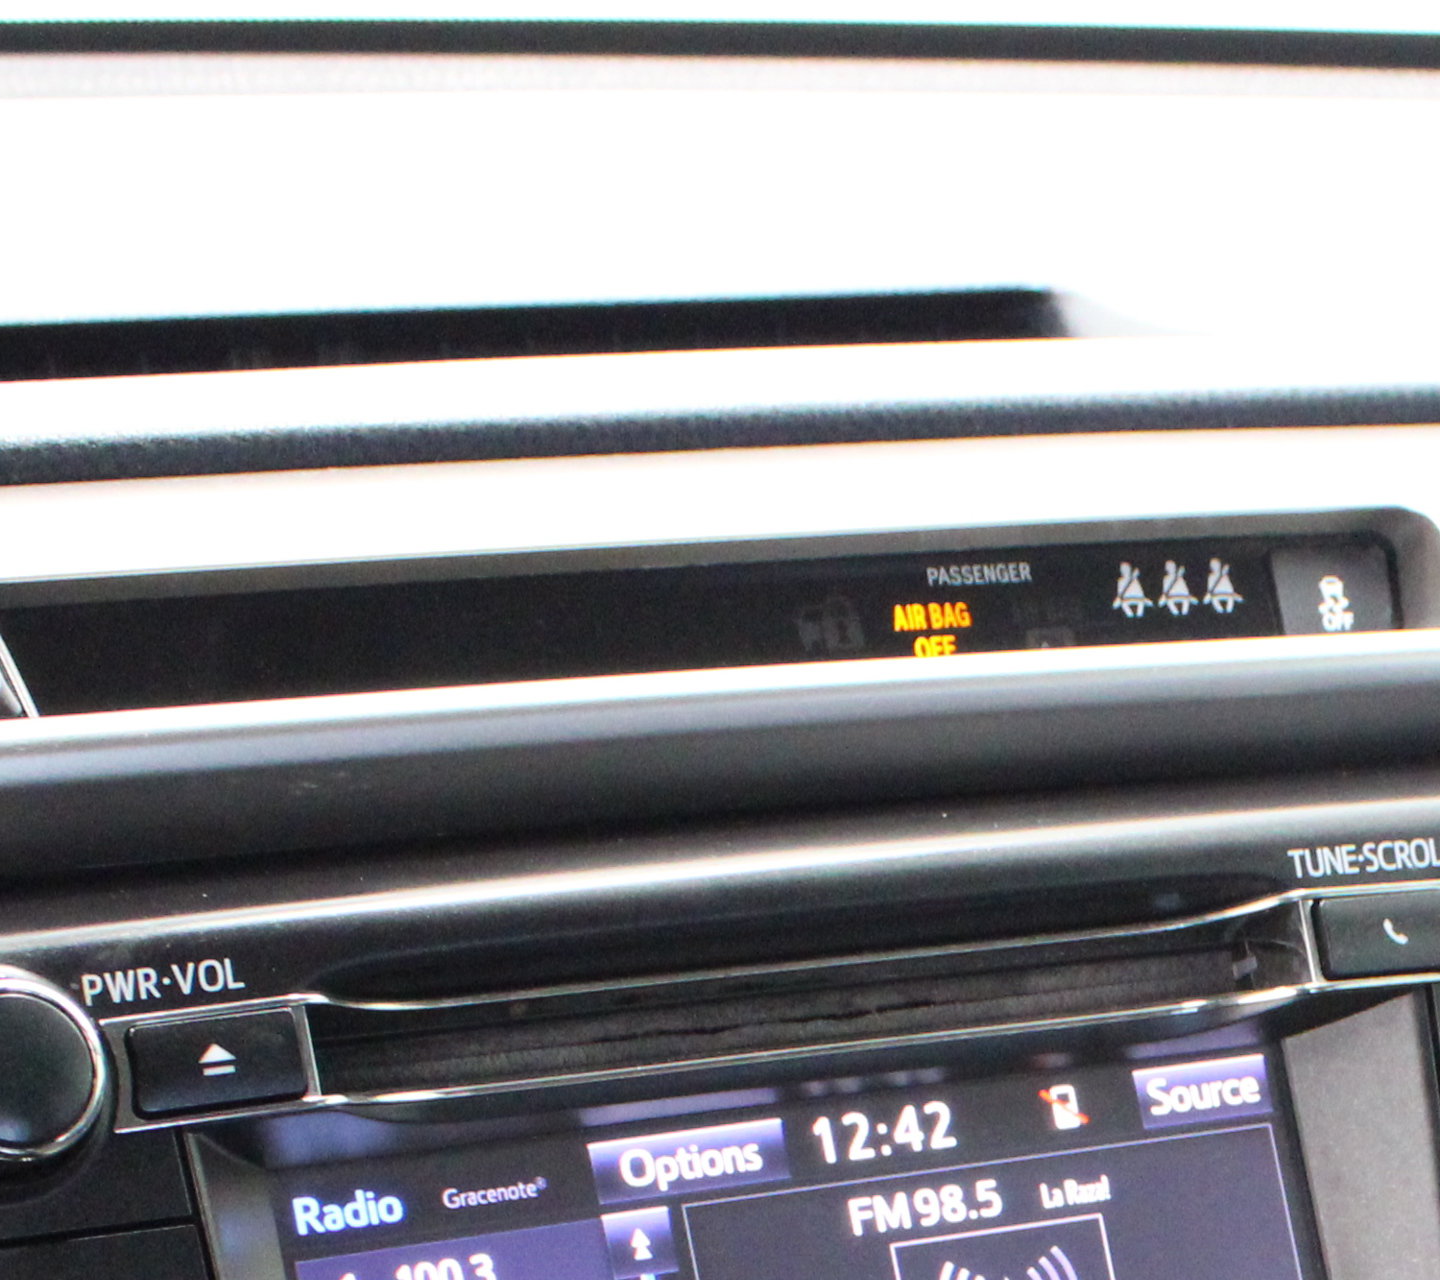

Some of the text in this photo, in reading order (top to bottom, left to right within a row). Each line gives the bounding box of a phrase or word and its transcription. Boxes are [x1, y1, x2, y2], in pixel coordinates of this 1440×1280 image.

[926, 561, 1033, 587] PASSENGER
[893, 601, 972, 632] AIR BAG
[1145, 1075, 1262, 1116] Source
[811, 1100, 958, 1164] 12:42
[618, 1141, 764, 1191] Options
[292, 1189, 405, 1236] Radio
